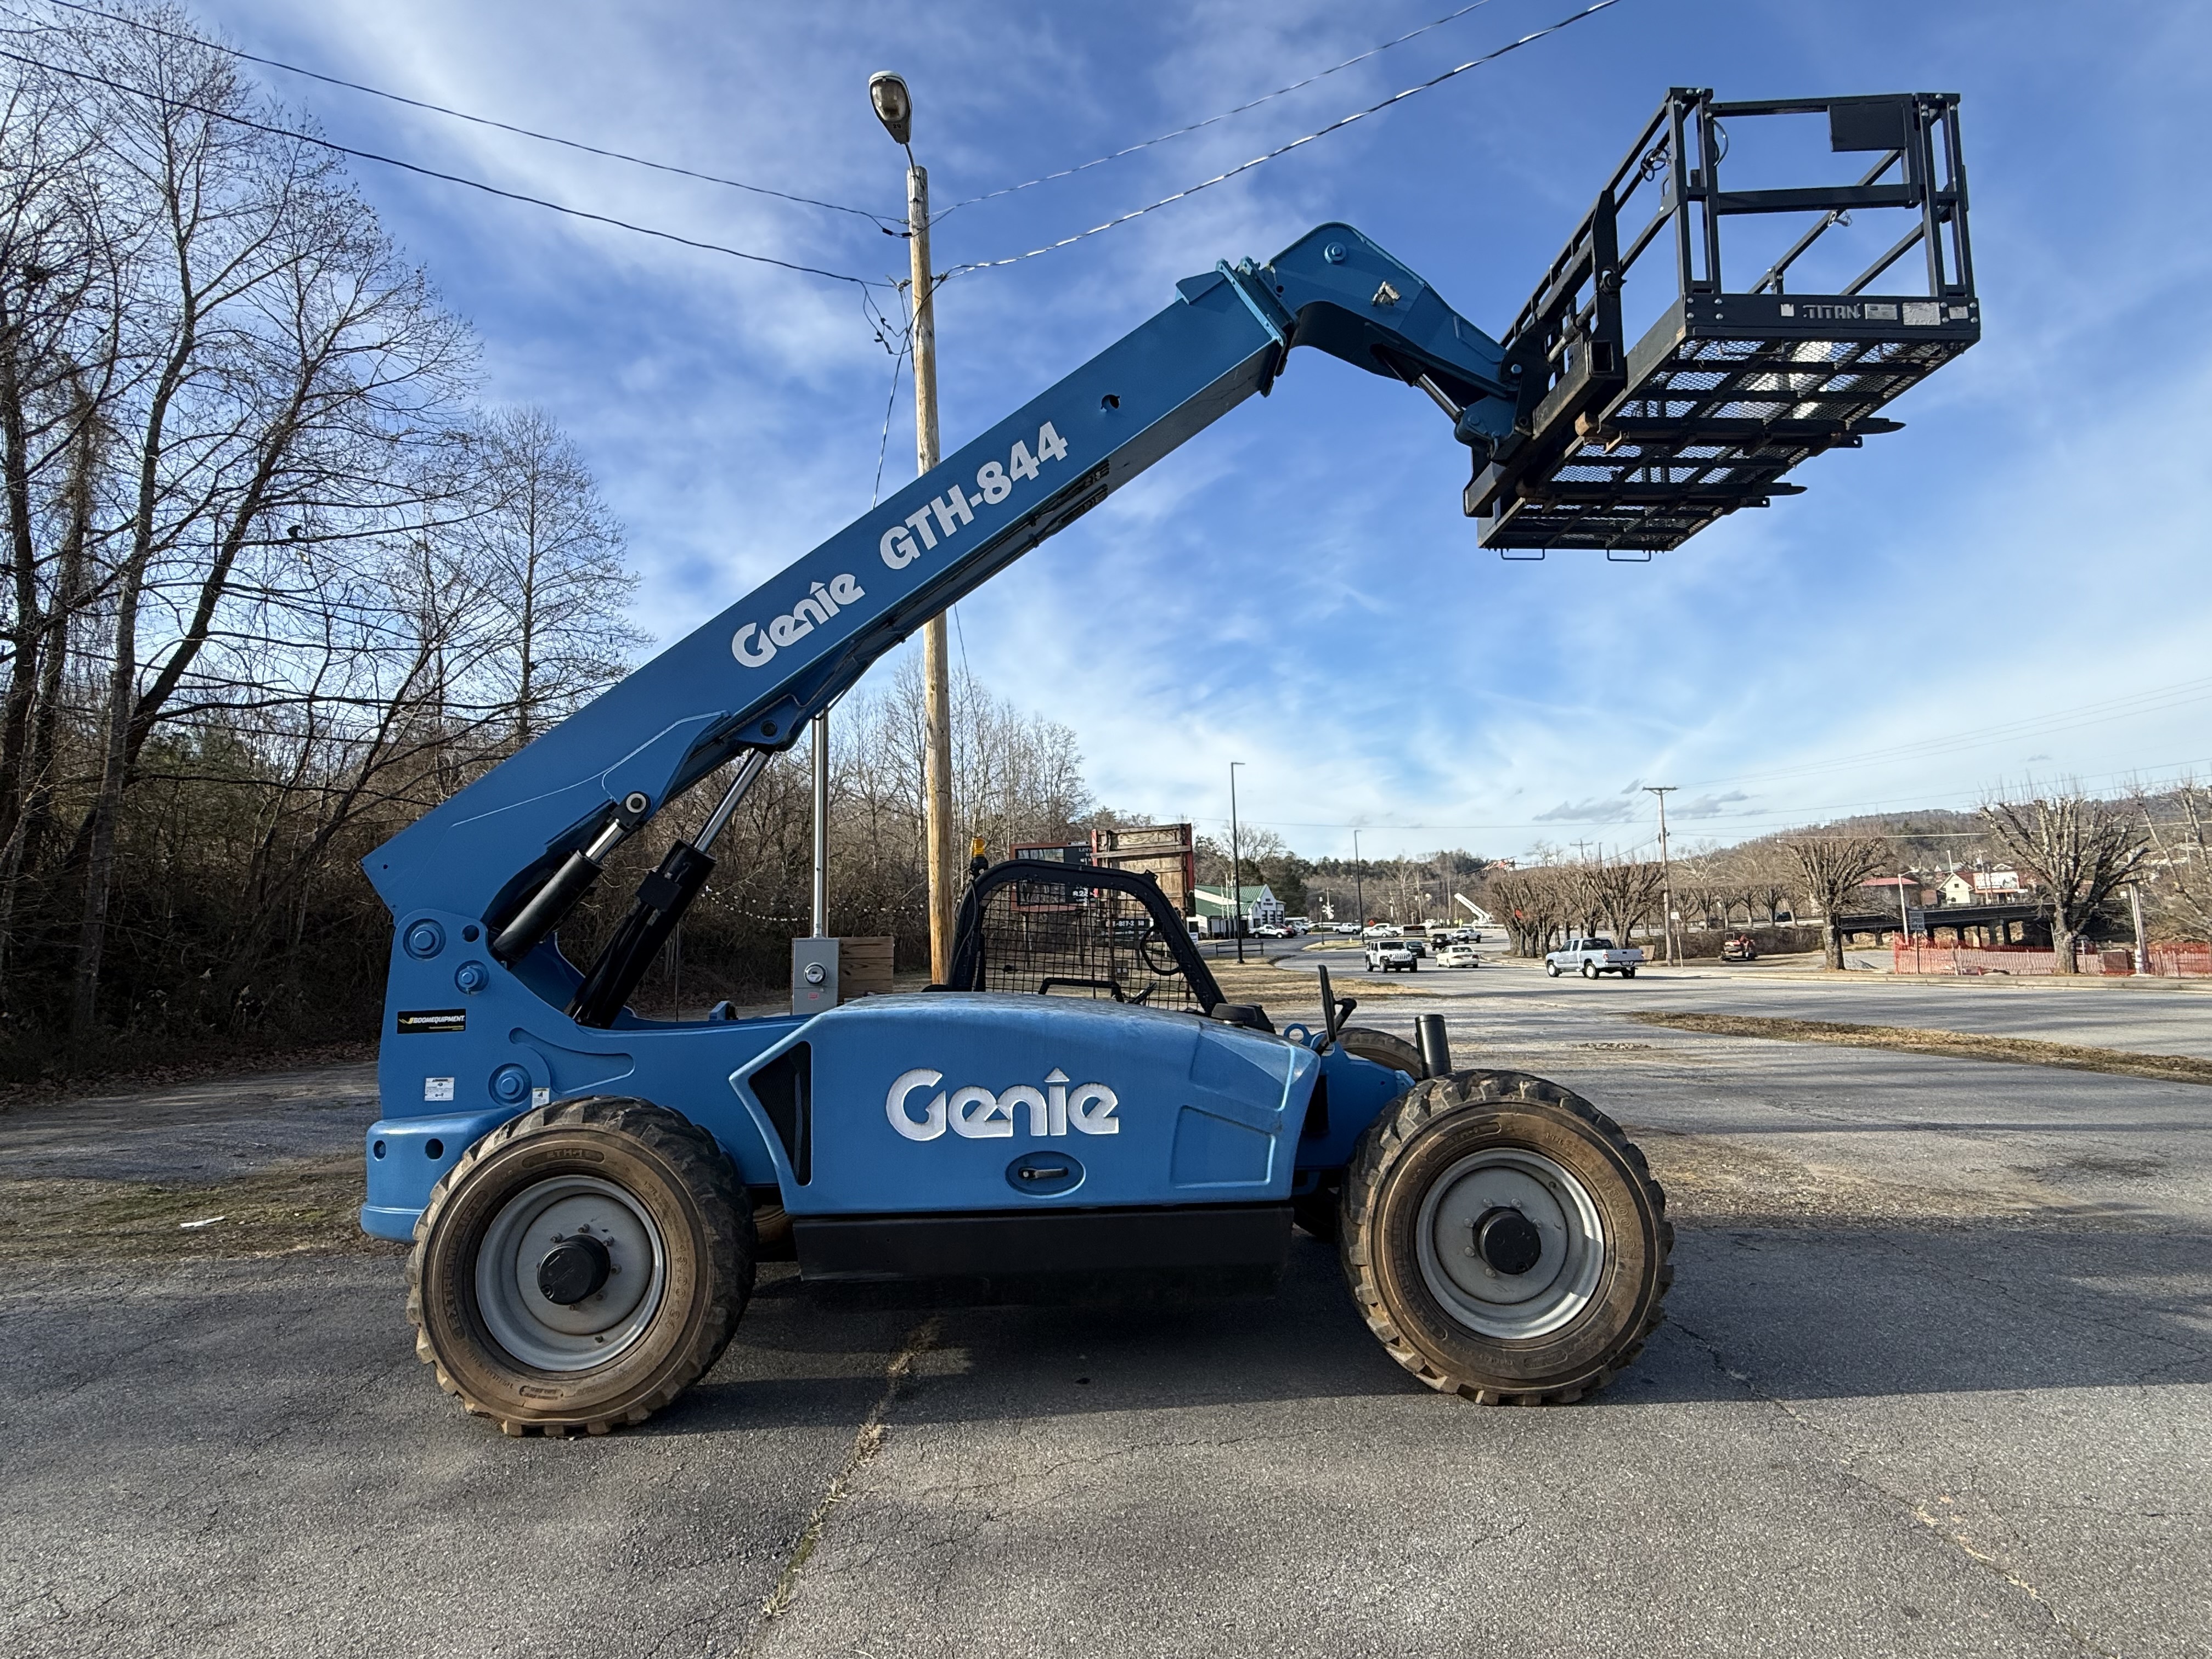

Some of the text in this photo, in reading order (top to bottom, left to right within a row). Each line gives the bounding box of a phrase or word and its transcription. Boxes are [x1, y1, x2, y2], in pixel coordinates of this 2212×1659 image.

[1803, 304, 1860, 319] TITAN
[880, 421, 1068, 570] GTH-844
[886, 1067, 1119, 1141] Genie
[443, 1198, 479, 1330] EXTREMELIFT
